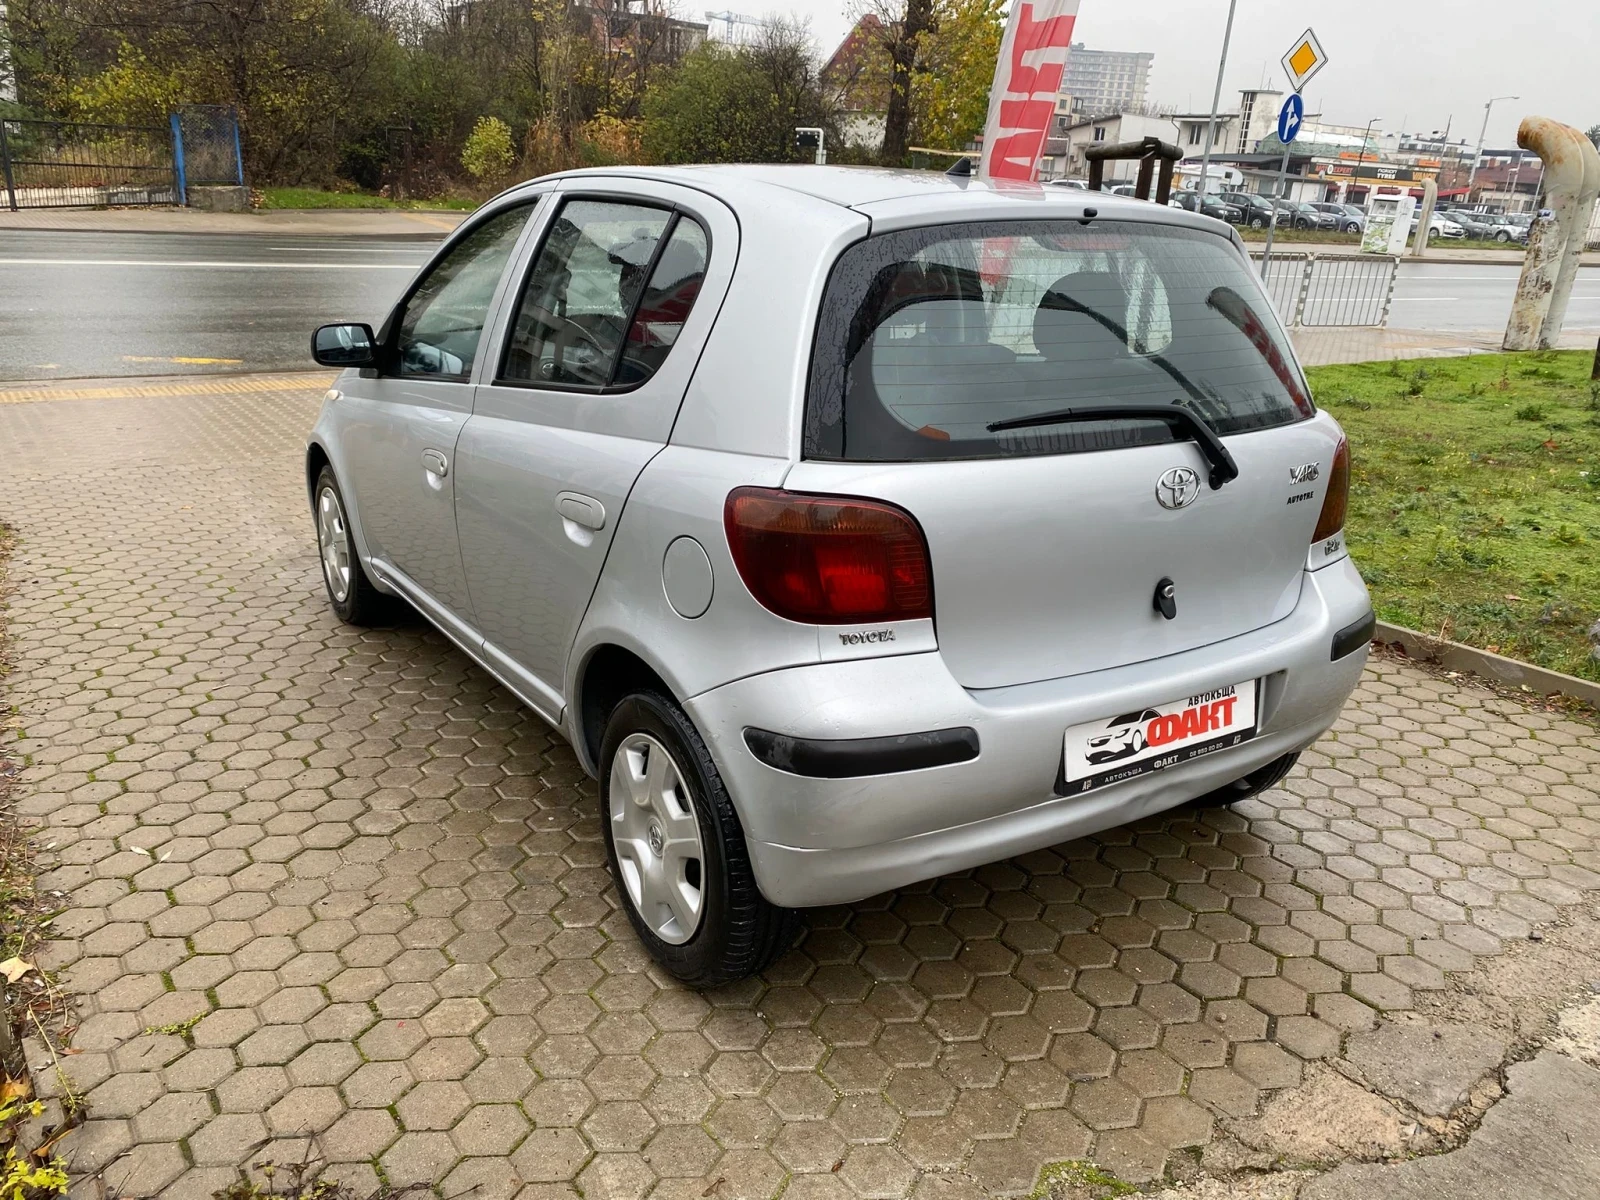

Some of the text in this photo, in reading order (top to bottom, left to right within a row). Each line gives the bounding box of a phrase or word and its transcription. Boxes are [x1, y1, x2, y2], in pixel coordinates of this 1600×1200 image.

[988, 3, 1077, 182] АКТ
[839, 628, 896, 646] TOYOTA
[1187, 685, 1236, 708] АВТОКЪЩА
[1147, 696, 1238, 748] ФАКТ
[1153, 754, 1179, 769] ФАКТ
